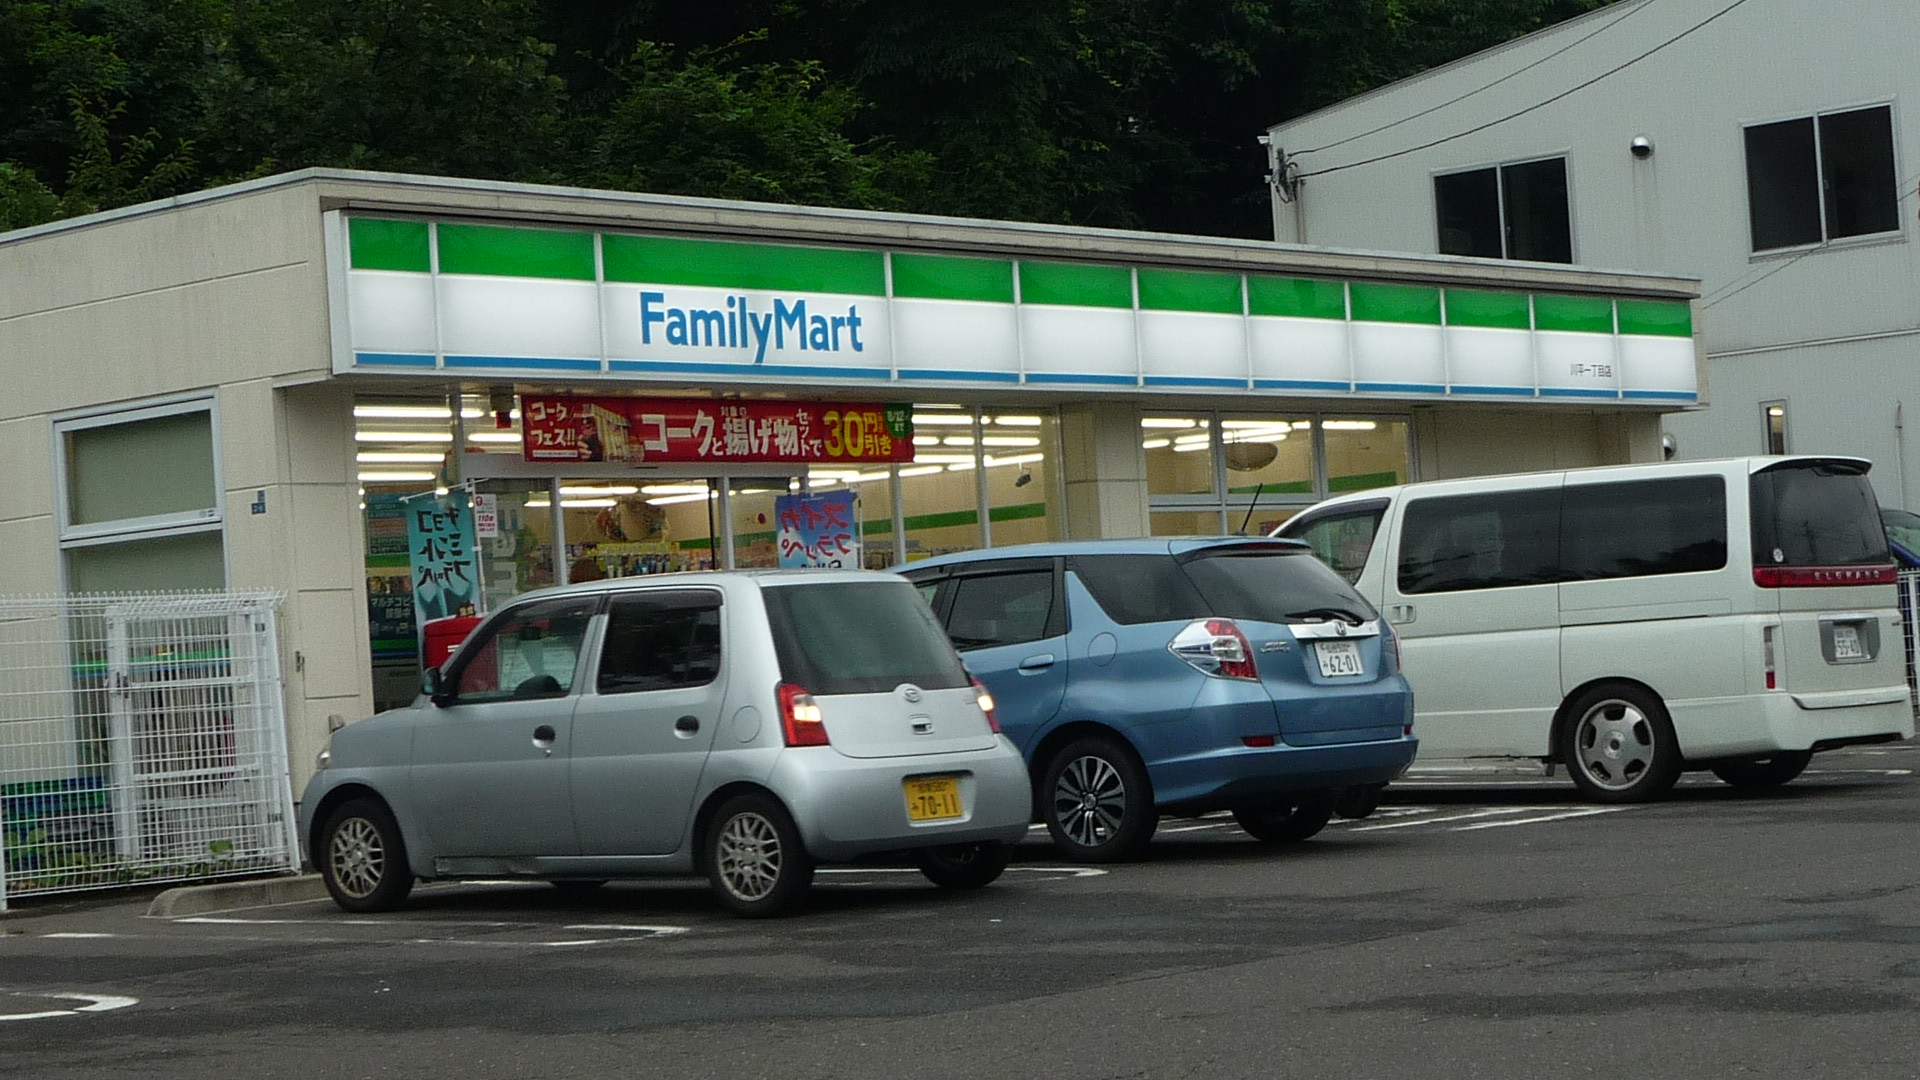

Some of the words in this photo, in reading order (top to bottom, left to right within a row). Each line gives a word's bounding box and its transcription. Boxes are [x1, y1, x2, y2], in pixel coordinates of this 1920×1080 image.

[640, 291, 863, 365] FamilyMart
[1570, 363, 1612, 378] 川平一丁目店
[531, 401, 568, 421] コーク
